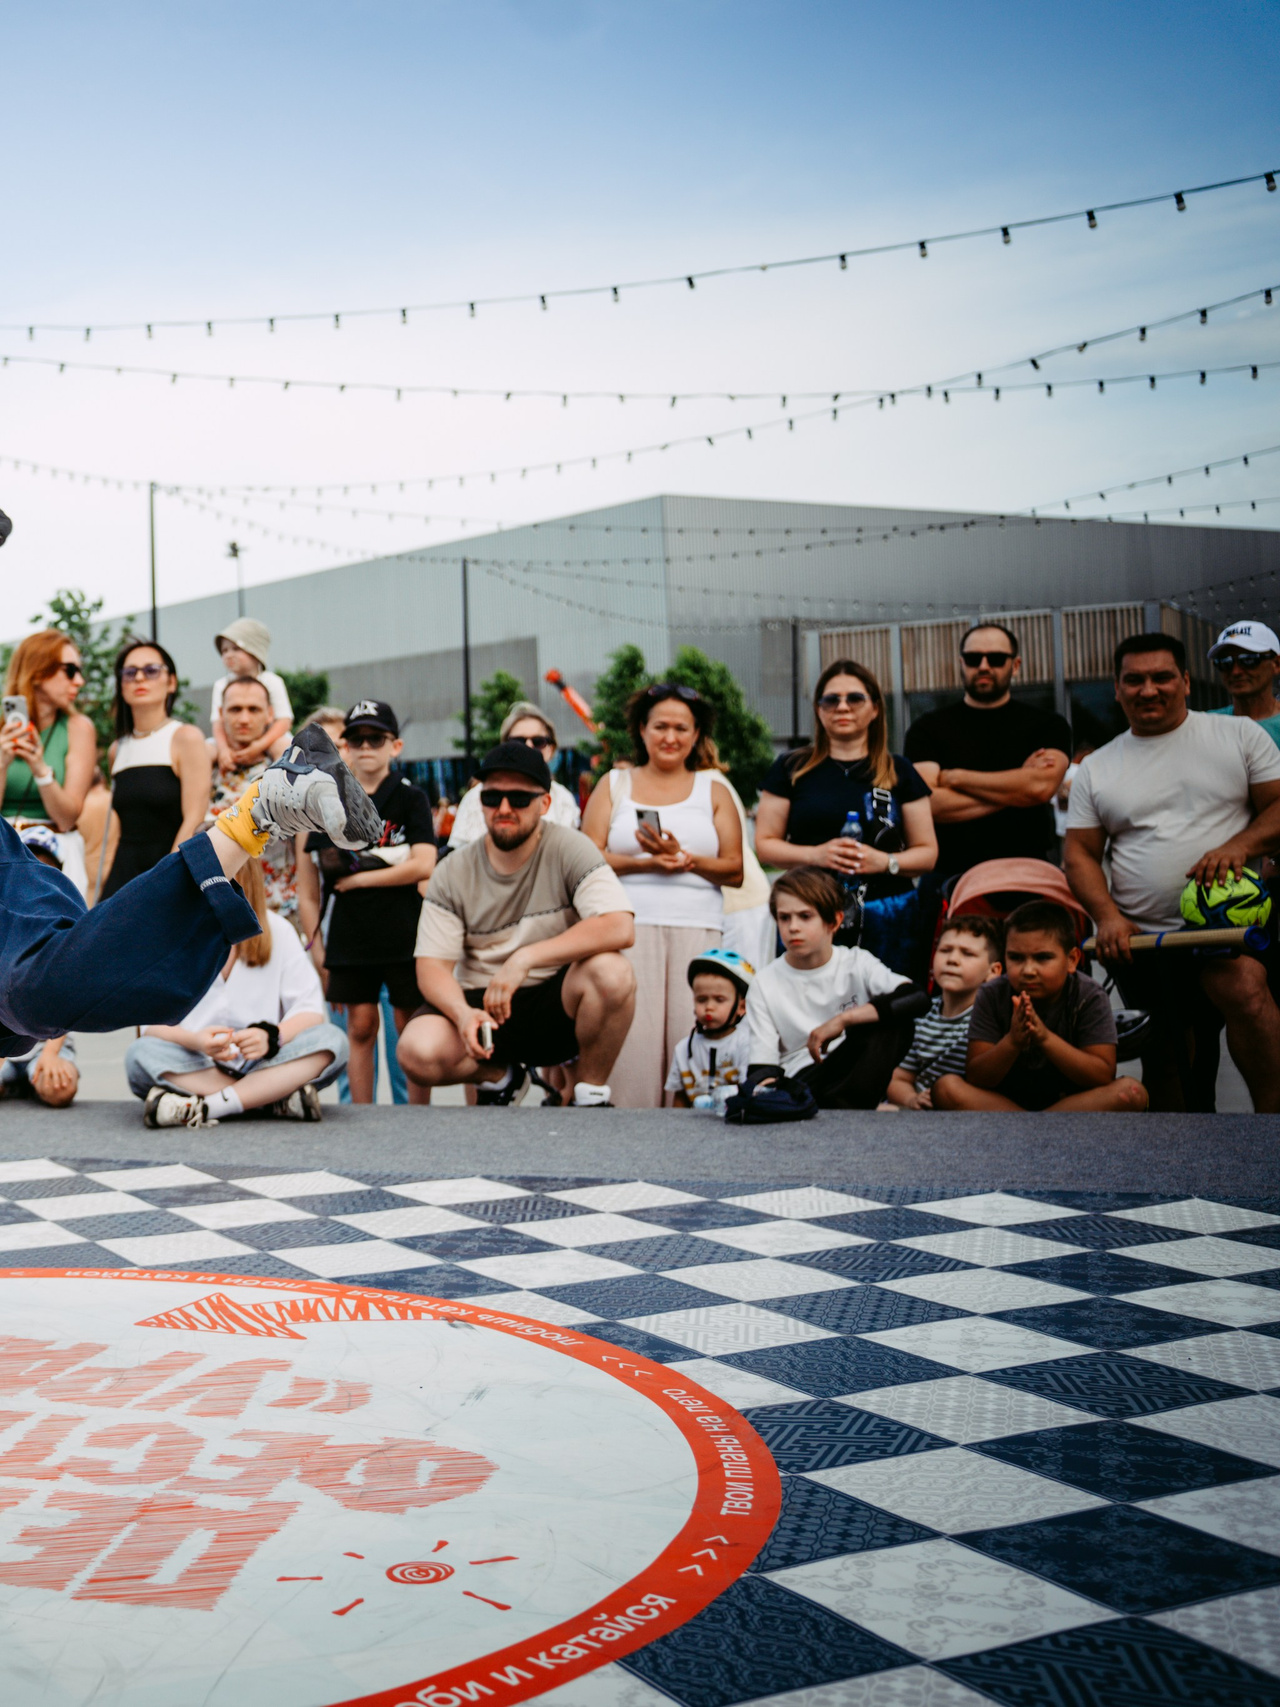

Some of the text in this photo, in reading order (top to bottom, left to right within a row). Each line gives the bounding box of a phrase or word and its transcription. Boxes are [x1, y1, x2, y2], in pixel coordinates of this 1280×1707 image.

[64, 1270, 189, 1282] катайся
[225, 1277, 307, 1290] люби
[346, 1288, 475, 1317] кататься
[476, 1312, 585, 1347] любишь
[662, 1388, 714, 1413] лето
[696, 1415, 731, 1432] на
[710, 1435, 753, 1479] планы
[489, 1665, 535, 1686] и
[526, 1592, 678, 1670] катайся
